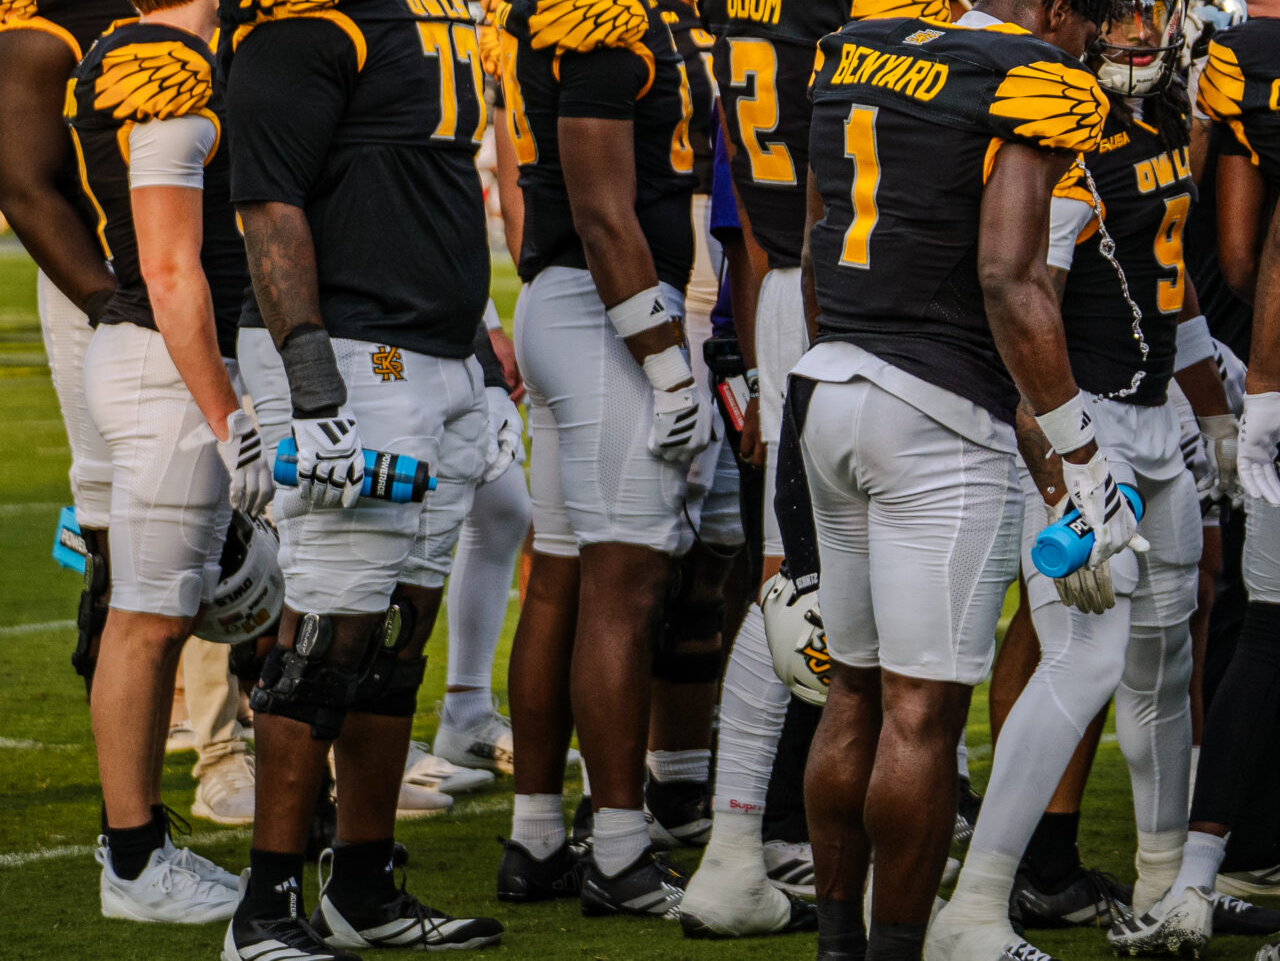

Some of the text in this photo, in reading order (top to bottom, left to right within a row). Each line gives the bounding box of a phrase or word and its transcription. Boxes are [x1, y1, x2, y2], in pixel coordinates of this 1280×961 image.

[416, 20, 488, 145] 77
[725, 37, 798, 187] 2
[831, 42, 949, 103] BENYARD
[838, 103, 881, 271] 1
[1154, 192, 1192, 316] 9
